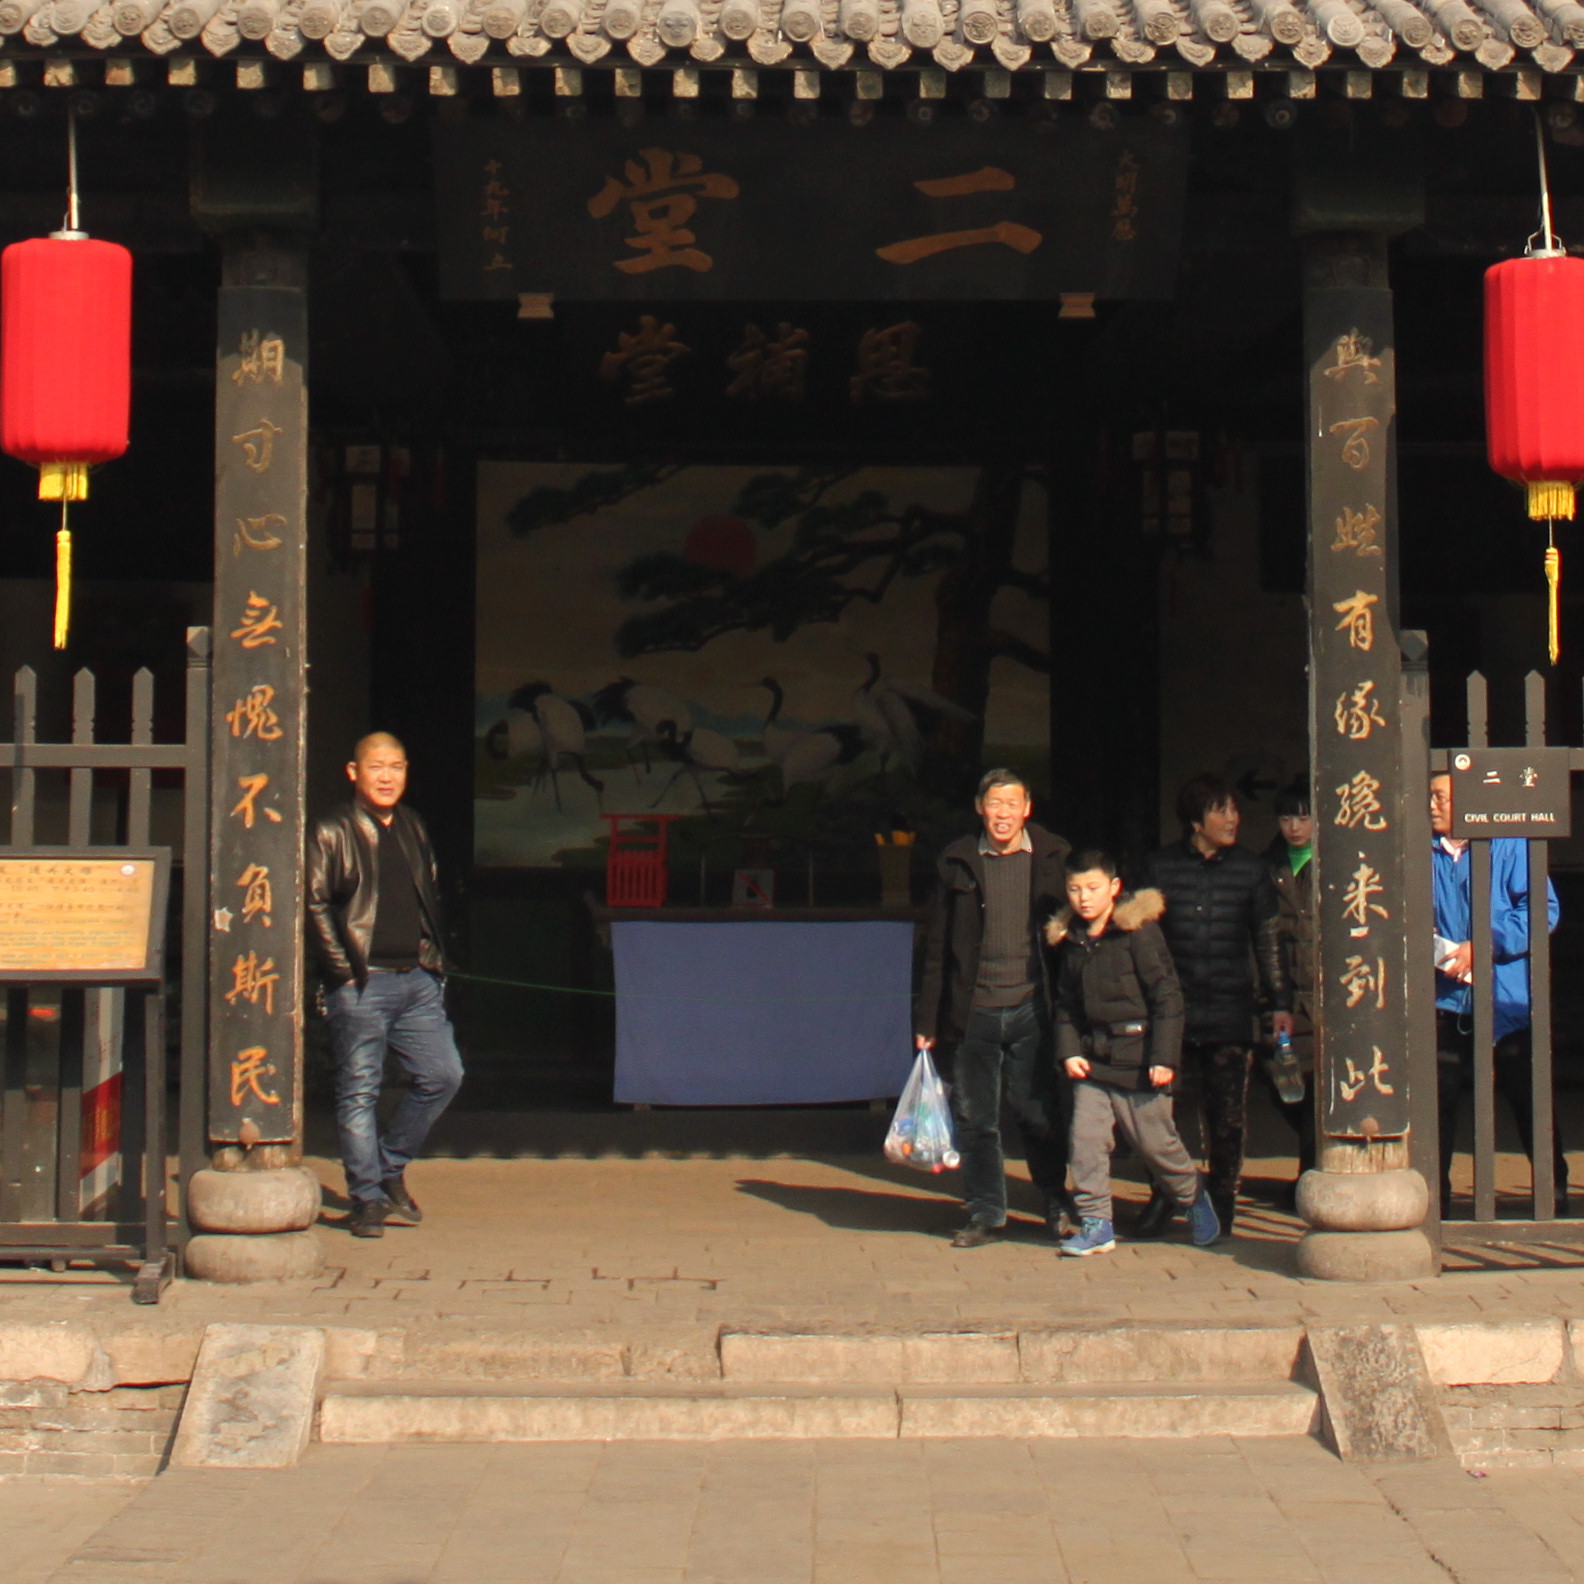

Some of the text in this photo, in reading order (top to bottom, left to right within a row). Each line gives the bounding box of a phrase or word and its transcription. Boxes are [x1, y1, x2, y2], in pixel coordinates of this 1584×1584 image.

[586, 146, 1043, 274] 二堂
[1482, 766, 1538, 788] 二堂
[1464, 812, 1556, 824] CIVIL COURT HALL
